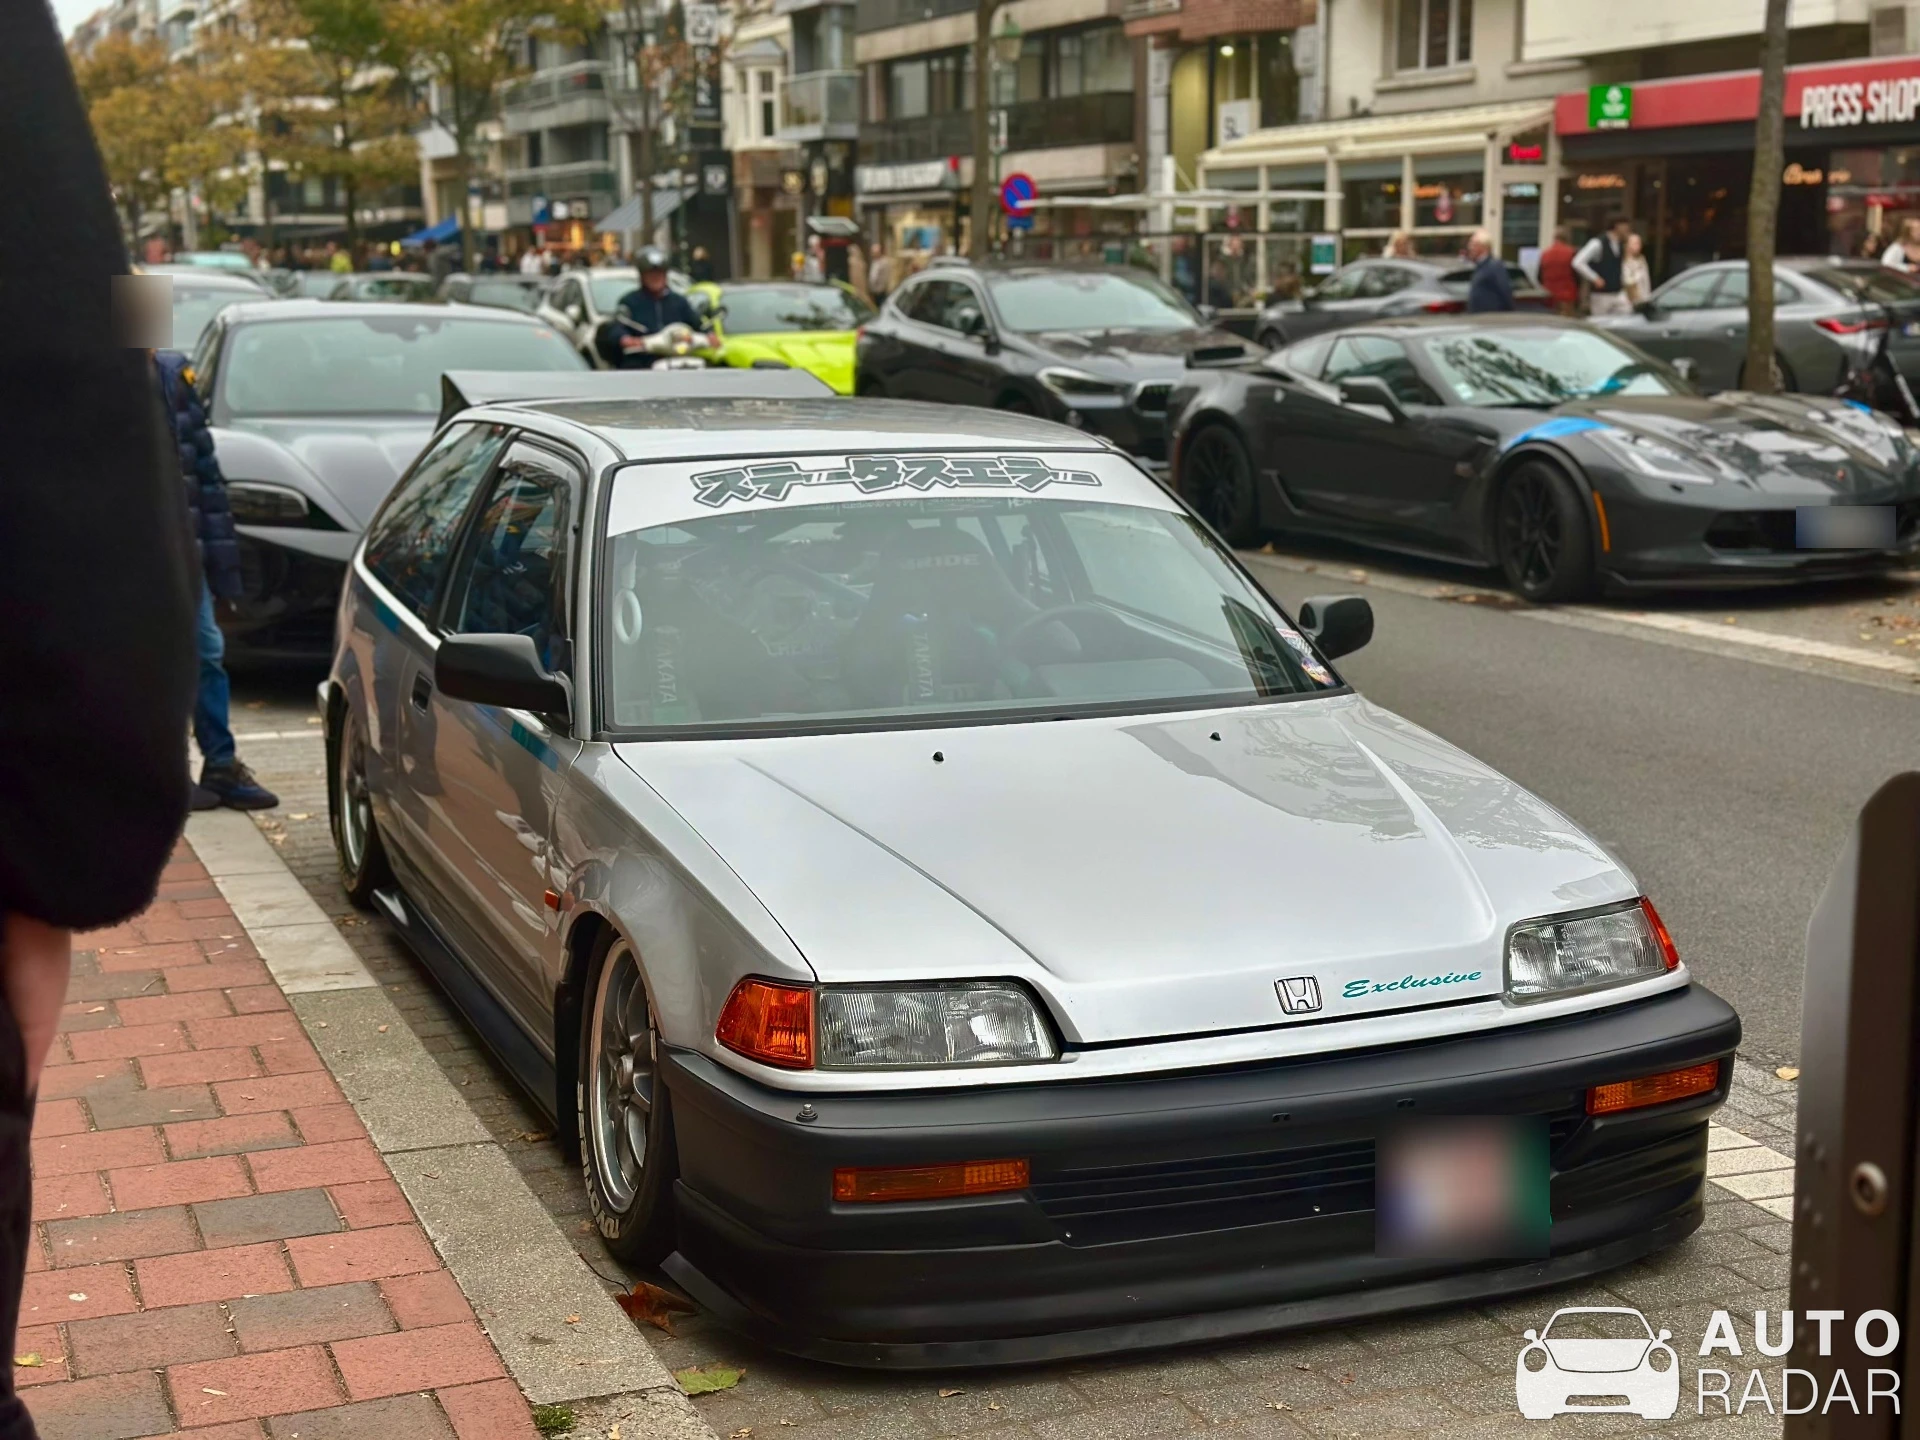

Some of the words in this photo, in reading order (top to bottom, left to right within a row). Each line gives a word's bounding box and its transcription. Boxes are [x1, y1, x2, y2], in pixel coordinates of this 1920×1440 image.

[1801, 84, 1863, 129] PRESS
[1866, 77, 1920, 123] SHOP
[913, 631, 934, 698] TAKATA
[1342, 971, 1482, 998] Exclusive
